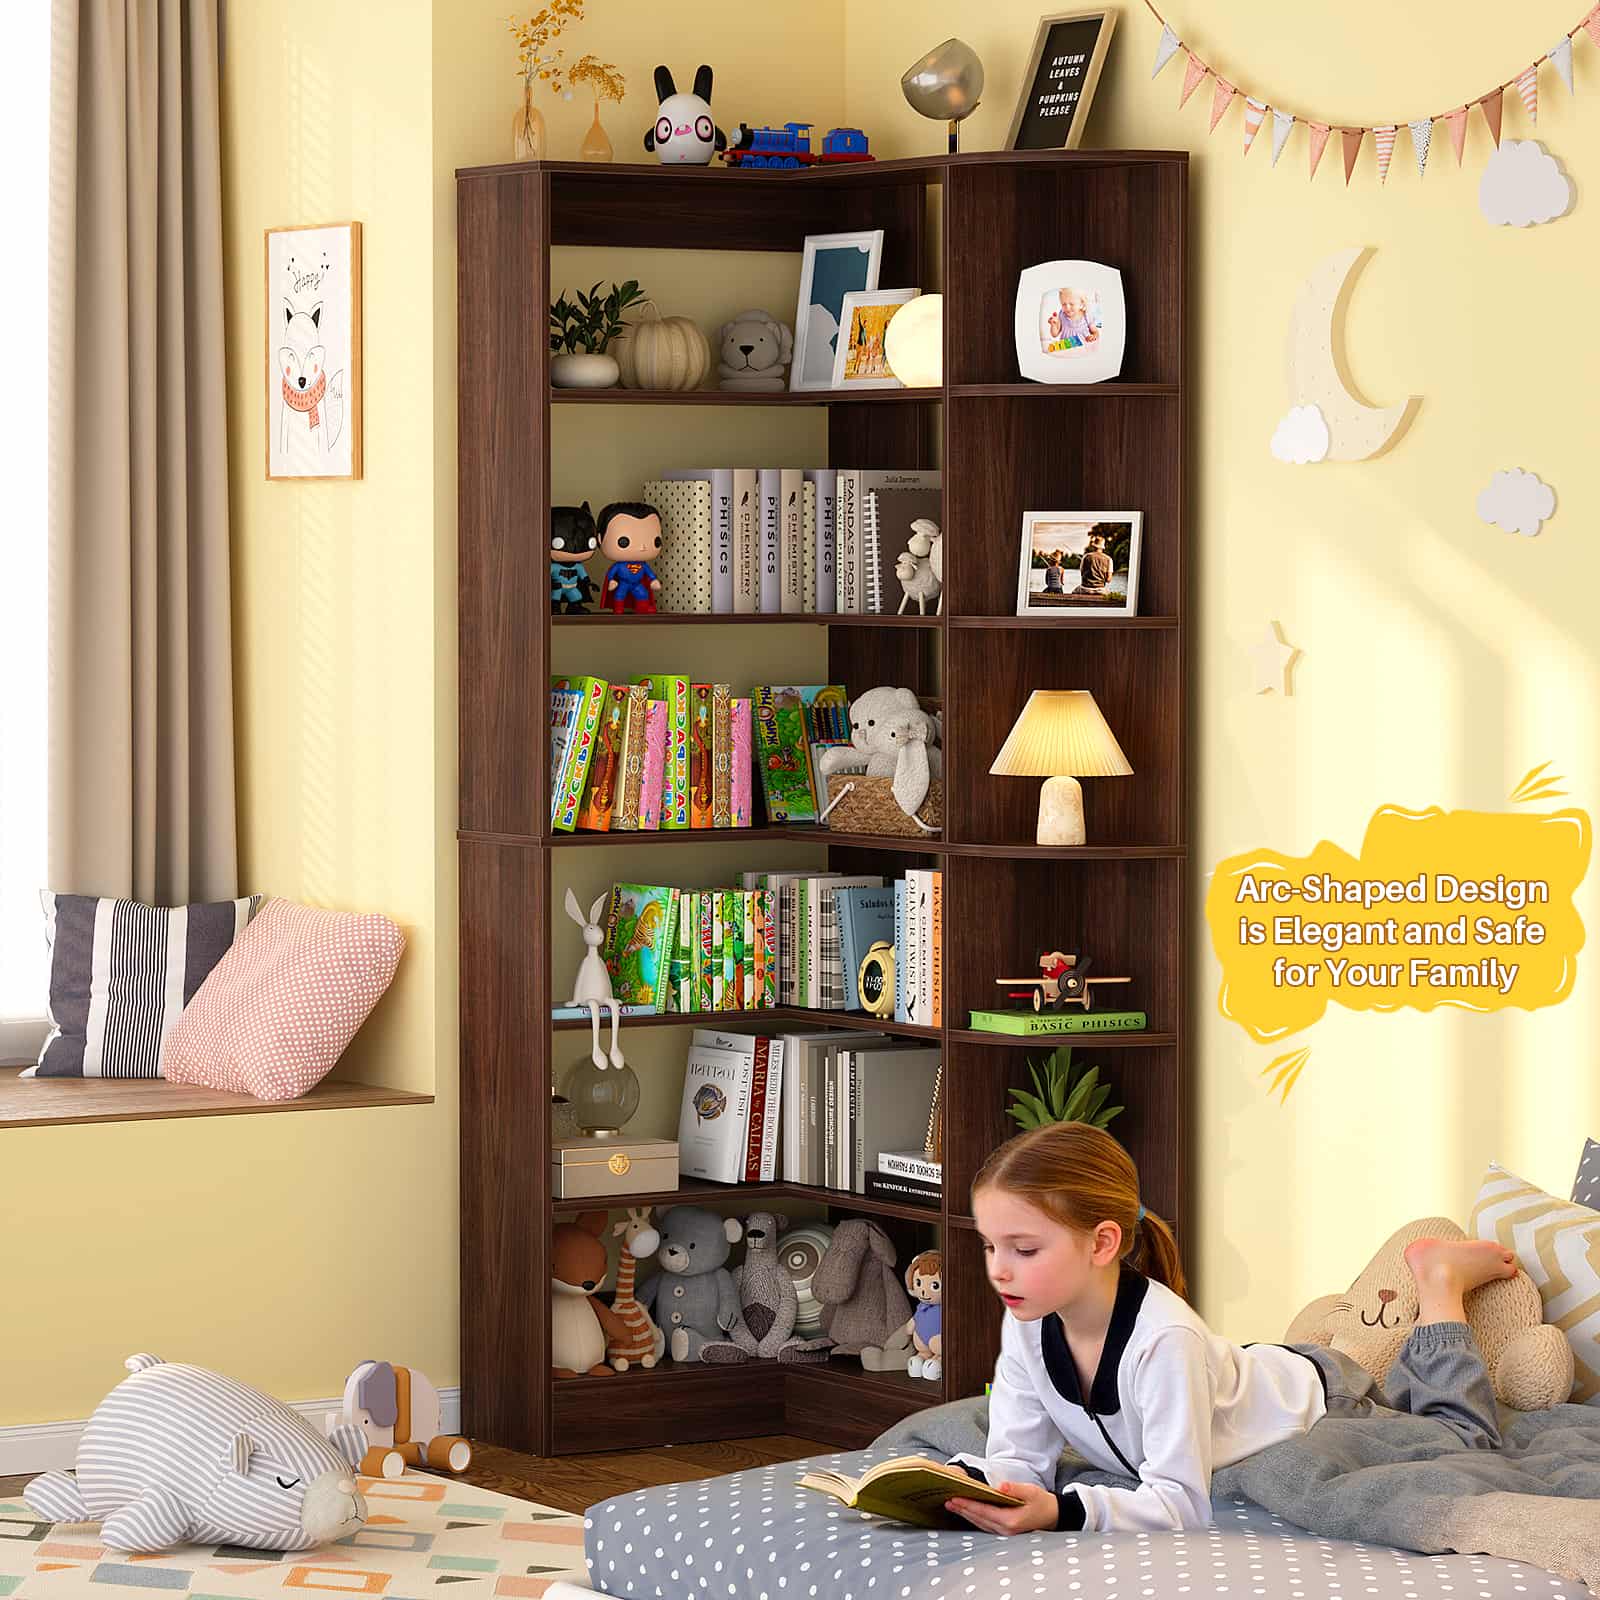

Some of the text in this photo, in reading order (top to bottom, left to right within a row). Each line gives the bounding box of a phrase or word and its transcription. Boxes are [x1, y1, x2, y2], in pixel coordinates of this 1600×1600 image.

[1049, 67, 1080, 79] LEAVES
[1052, 54, 1085, 67] AUTUMN
[1038, 92, 1079, 105] PUMPKINS
[1040, 105, 1071, 117] PLEASE
[719, 496, 728, 574] PHISICS
[767, 496, 776, 574] PHISICS
[824, 496, 832, 574] PHISICS
[1030, 1021, 1073, 1031] BASIC
[1082, 1018, 1141, 1029] PHISICS
[737, 1056, 751, 1117] LOST FISH
[754, 1044, 768, 1096] MARIA
[762, 1044, 781, 1175] MILES REDD THE BOOK OF CHIC
[748, 1111, 763, 1172] CALLAS
